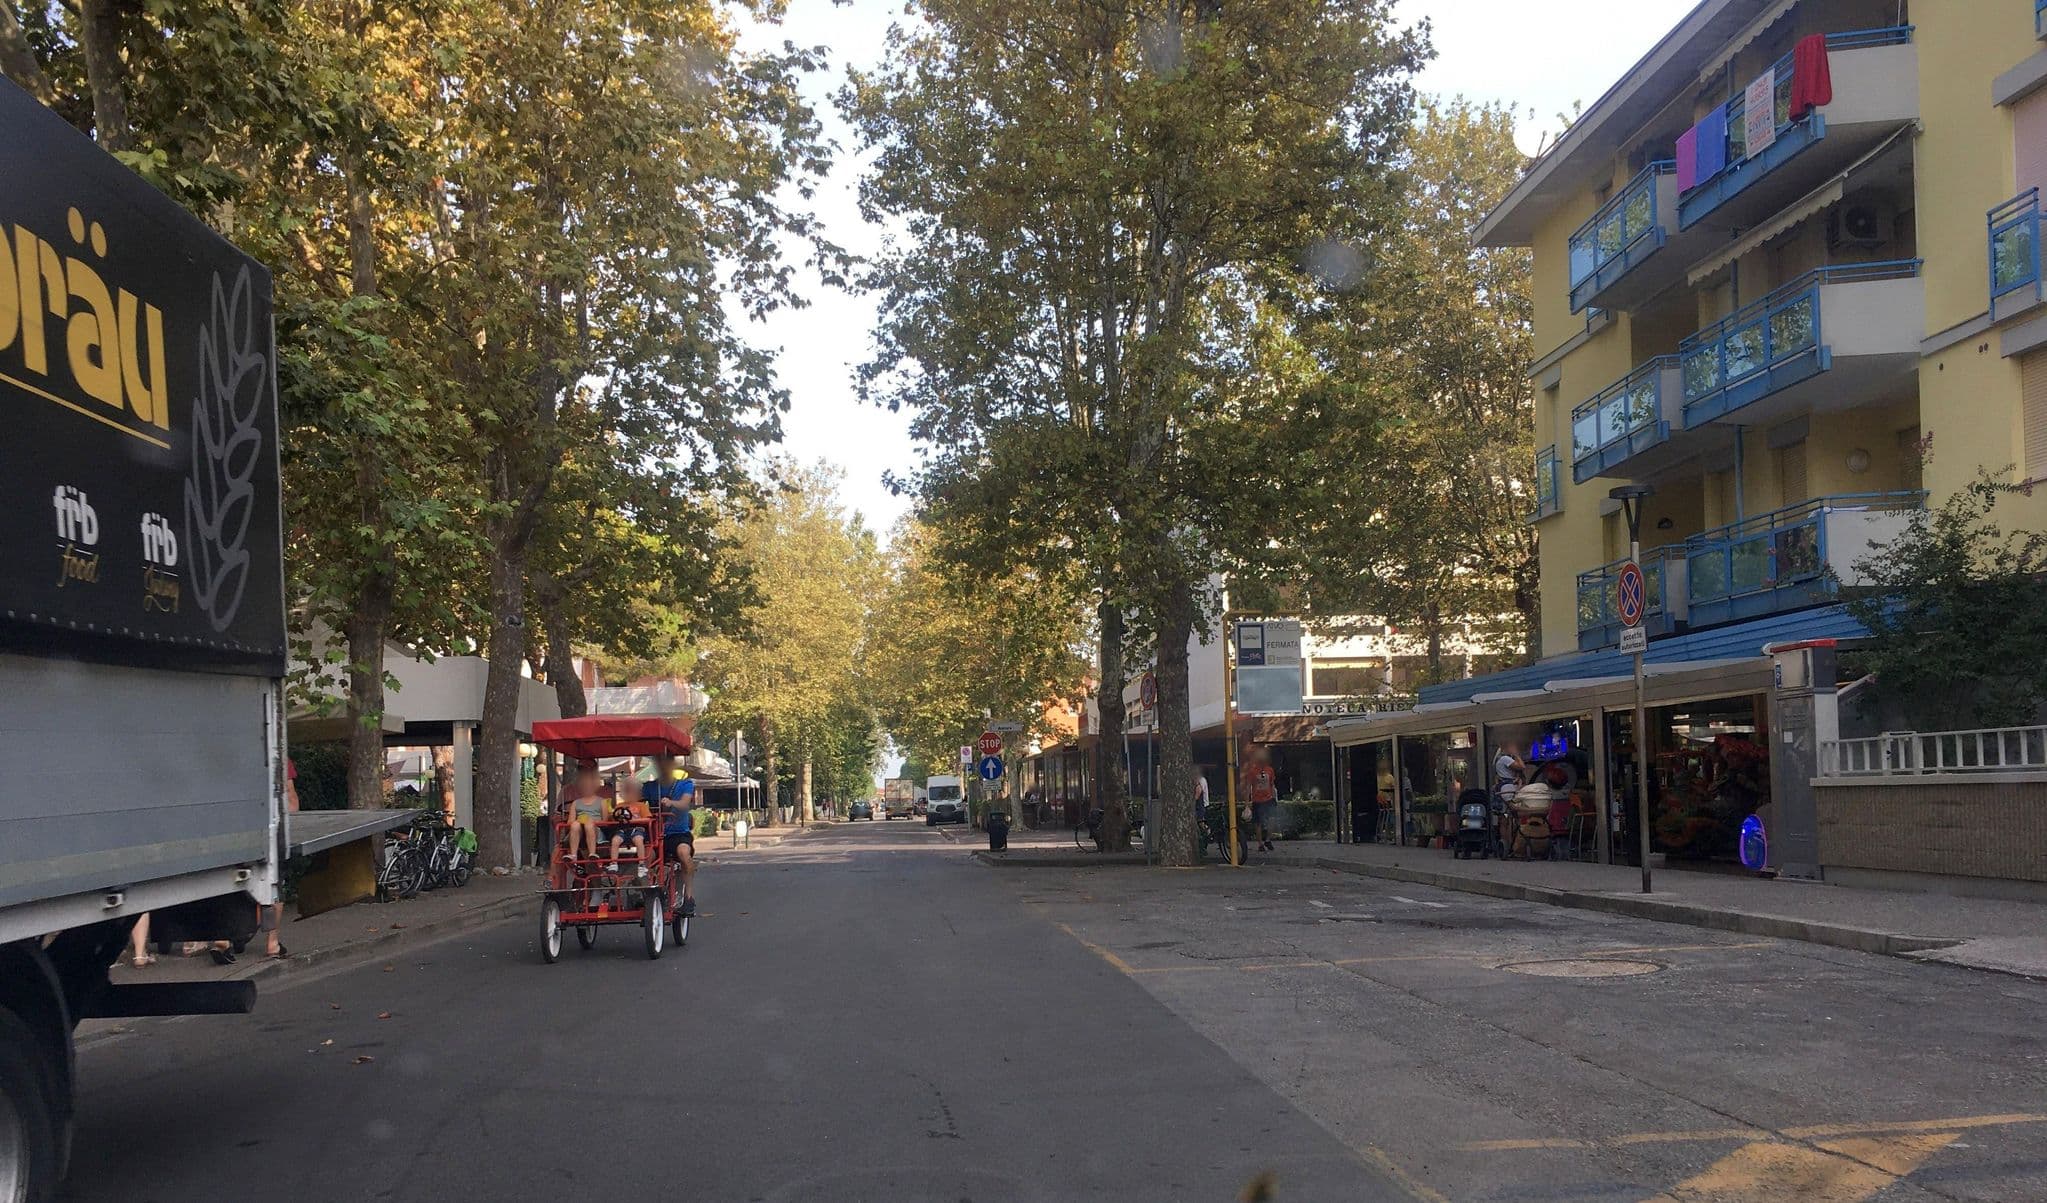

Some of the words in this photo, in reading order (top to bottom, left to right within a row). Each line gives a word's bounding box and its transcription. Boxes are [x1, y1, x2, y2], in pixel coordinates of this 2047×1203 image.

[1266, 640, 1299, 649] FERMATA
[1301, 703, 1366, 714] NOTECA
[980, 739, 1000, 749] STOP
